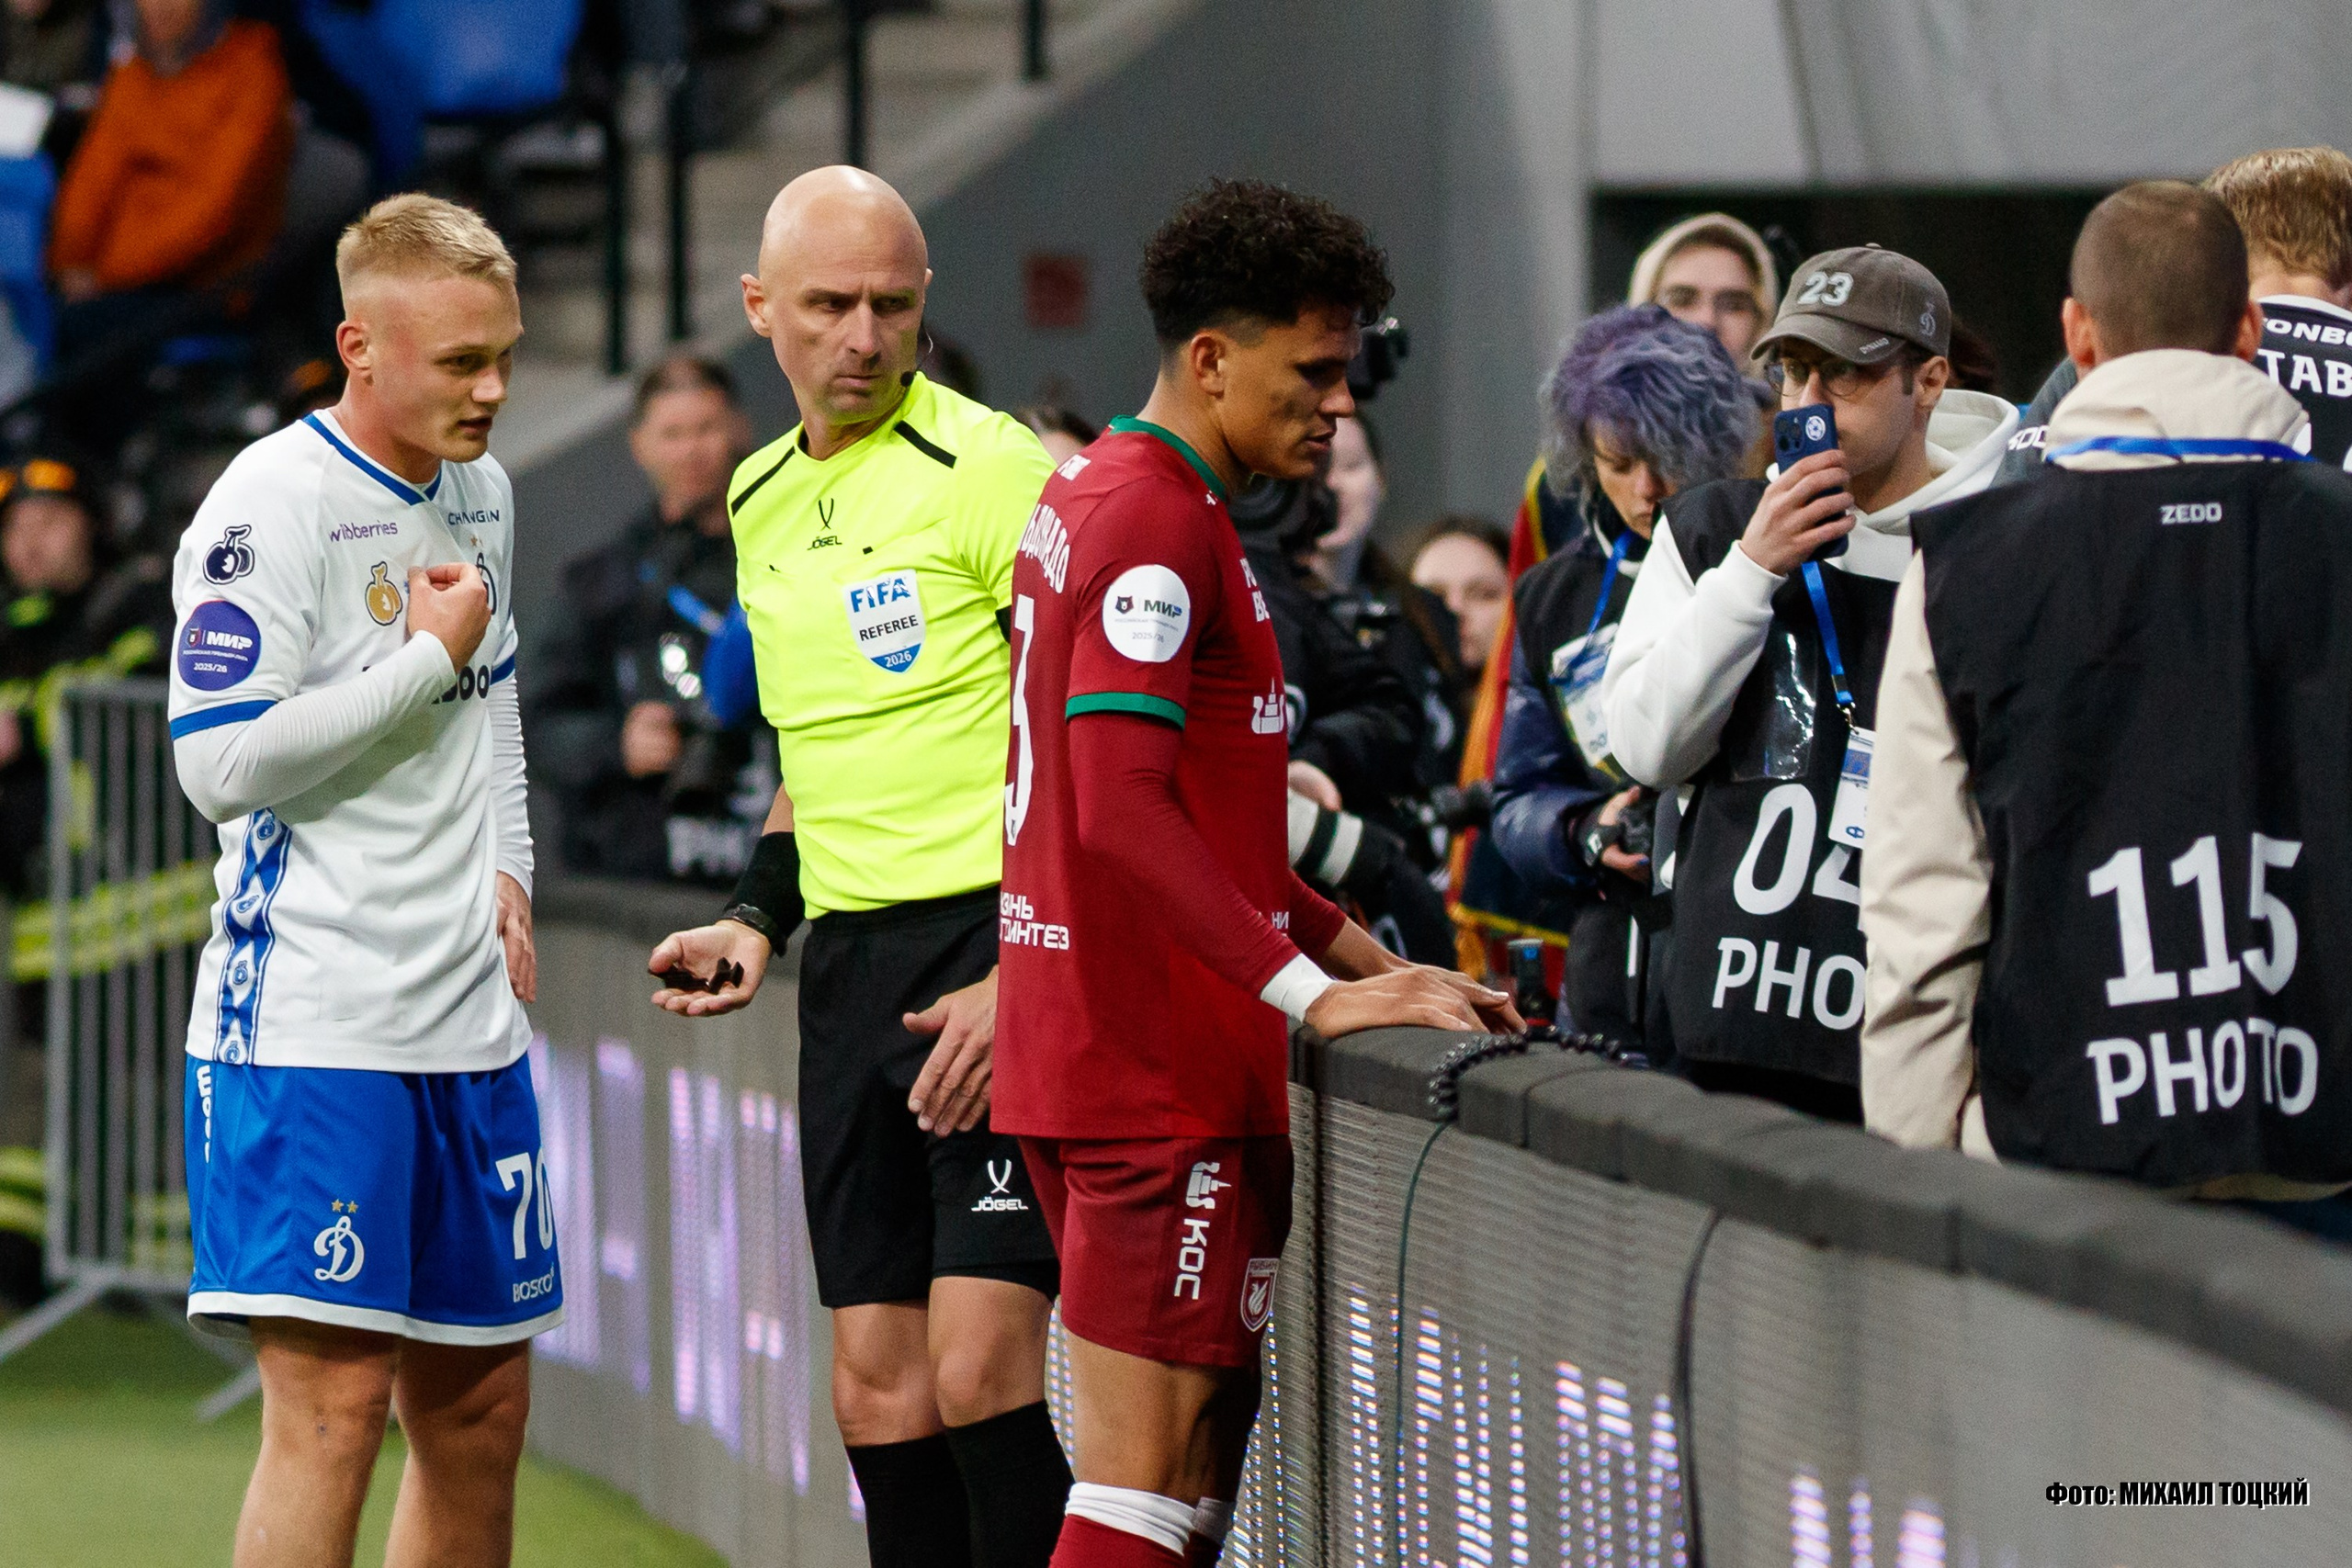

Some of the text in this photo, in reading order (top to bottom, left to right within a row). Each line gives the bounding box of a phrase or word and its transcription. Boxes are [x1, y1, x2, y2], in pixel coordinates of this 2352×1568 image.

[1797, 271, 1854, 307] 23
[2263, 318, 2352, 346] ONB
[850, 578, 911, 613] FIFA
[1144, 600, 1182, 618] МИР
[207, 631, 253, 650] МИР
[859, 615, 919, 641] REFEREE
[193, 662, 228, 673] 2025/26
[885, 650, 912, 668] 2026
[1001, 891, 1034, 920] ЗНЬ
[2087, 831, 2303, 1007] 115
[2086, 1017, 2318, 1124] PHOTO
[495, 1147, 553, 1259] 70
[971, 1196, 1029, 1212] JÖGEL
[513, 1274, 554, 1303] BOSCO
